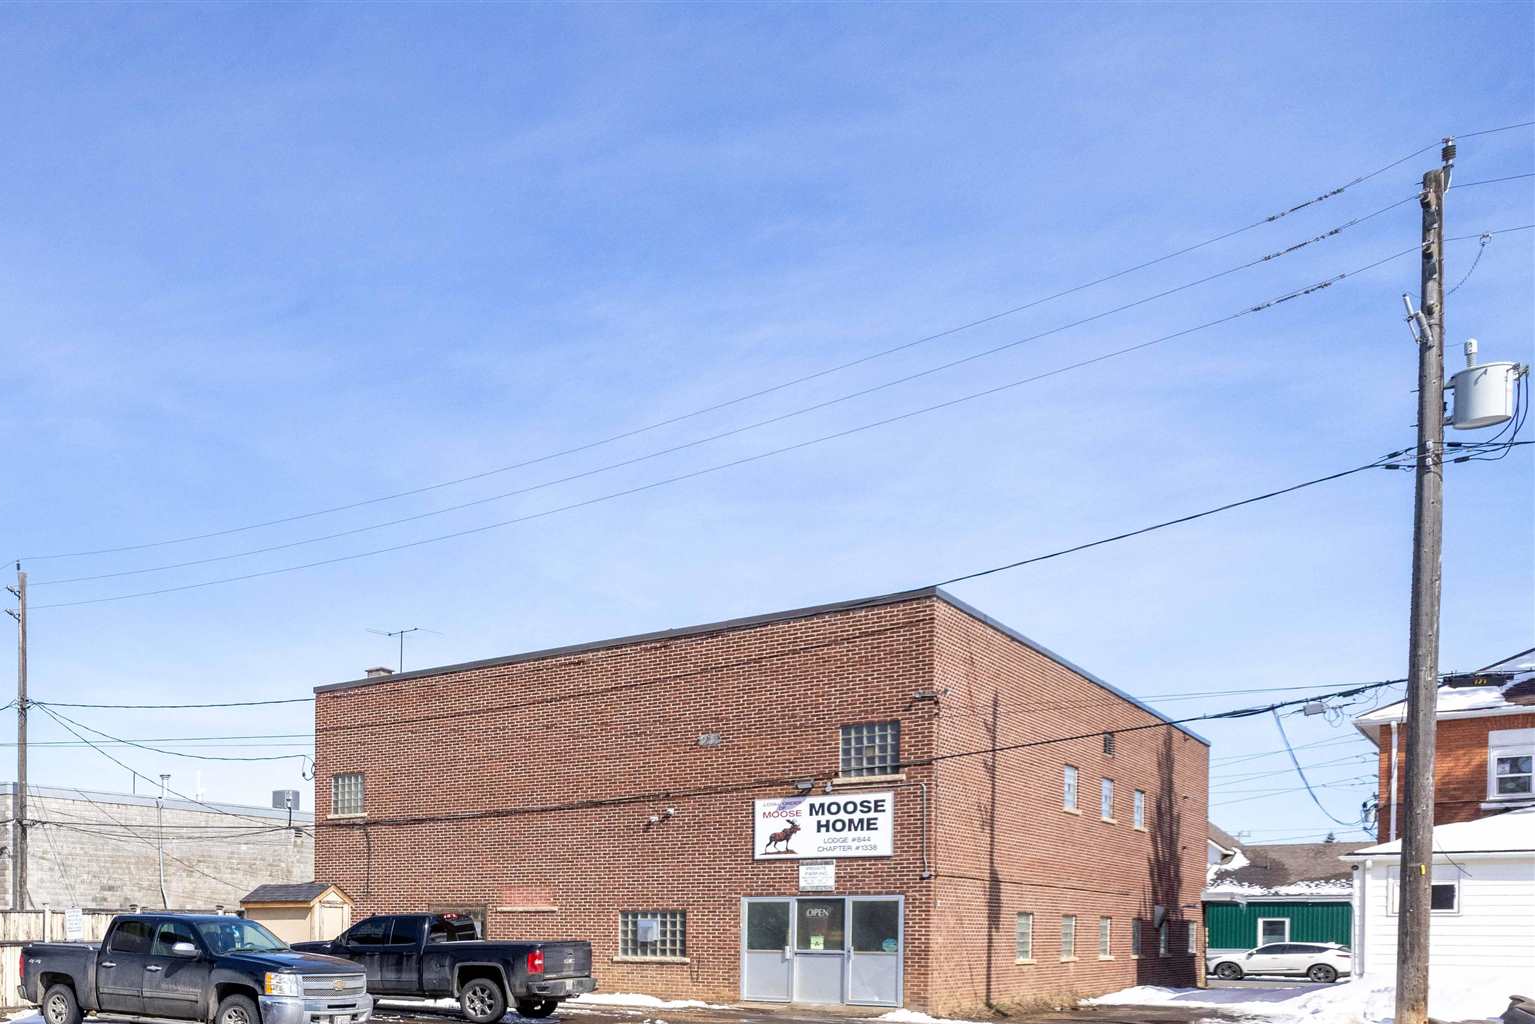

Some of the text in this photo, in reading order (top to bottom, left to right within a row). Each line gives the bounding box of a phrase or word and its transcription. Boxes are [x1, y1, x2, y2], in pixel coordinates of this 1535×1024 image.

[809, 799, 886, 816] MOOSE
[763, 810, 802, 818] MOOSE
[816, 818, 878, 832] HOME
[806, 908, 830, 917] OPEN
